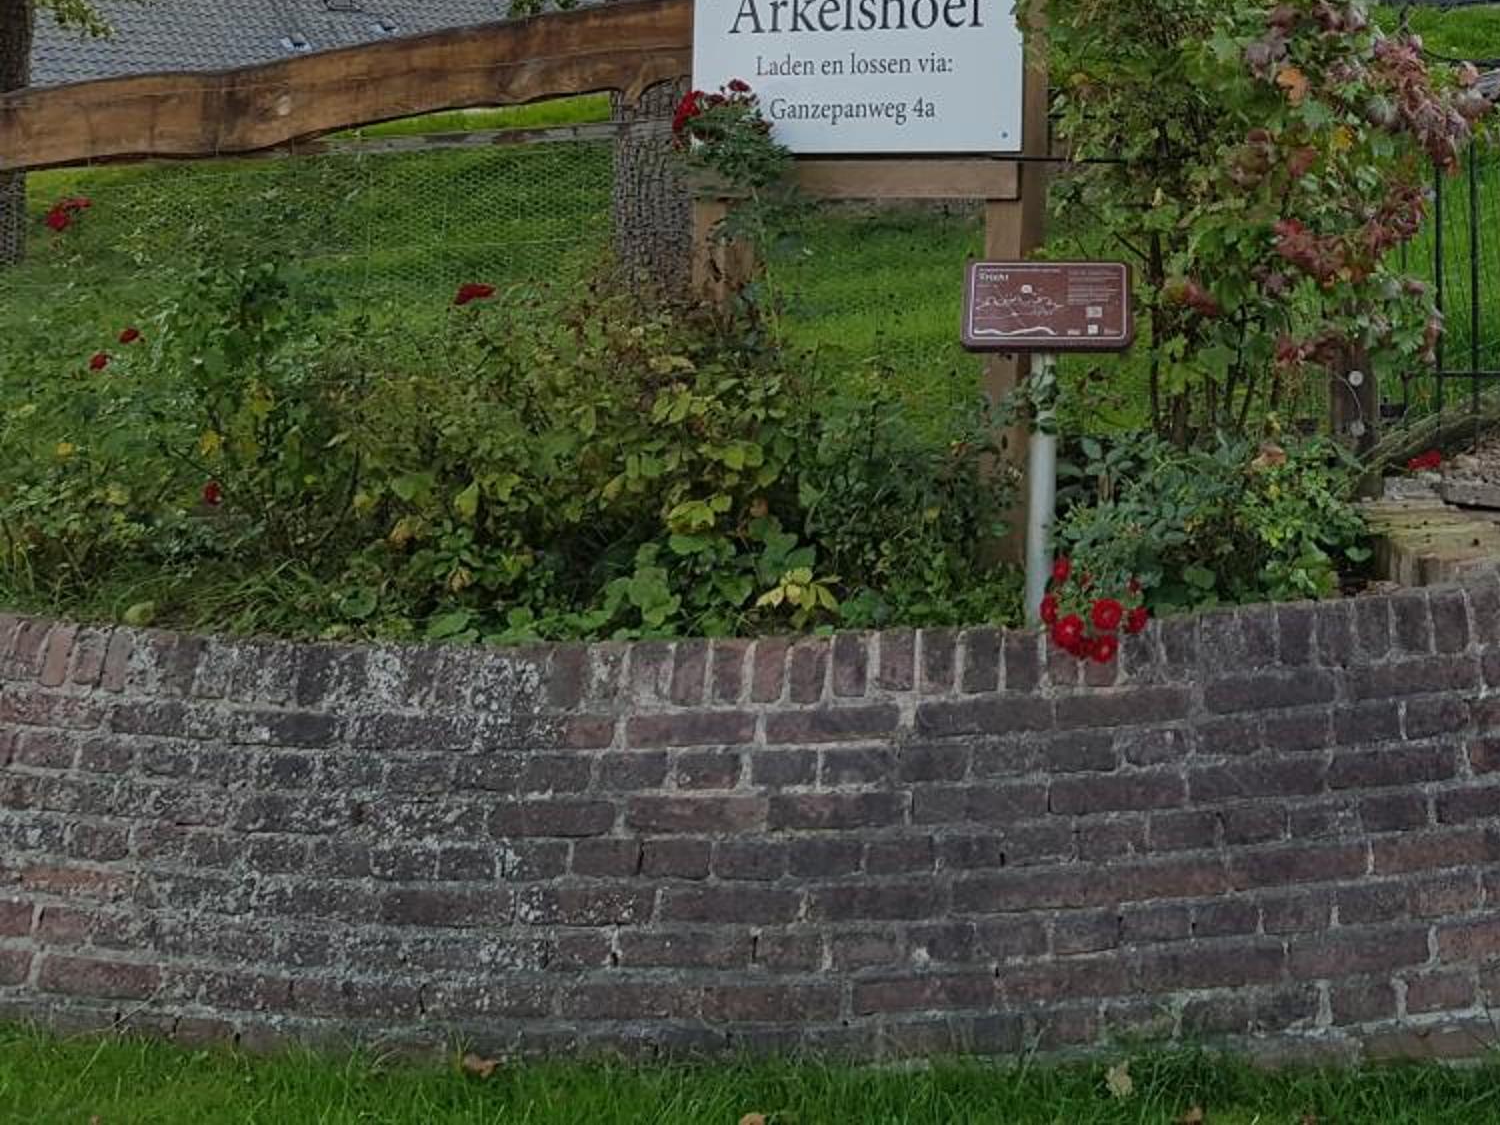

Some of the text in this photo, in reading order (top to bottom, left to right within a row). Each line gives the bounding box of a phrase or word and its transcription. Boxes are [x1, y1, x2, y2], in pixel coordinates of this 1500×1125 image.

[756, 51, 953, 77] Laden en lossen via:
[769, 97, 935, 125] Ganzepanweg 4a
